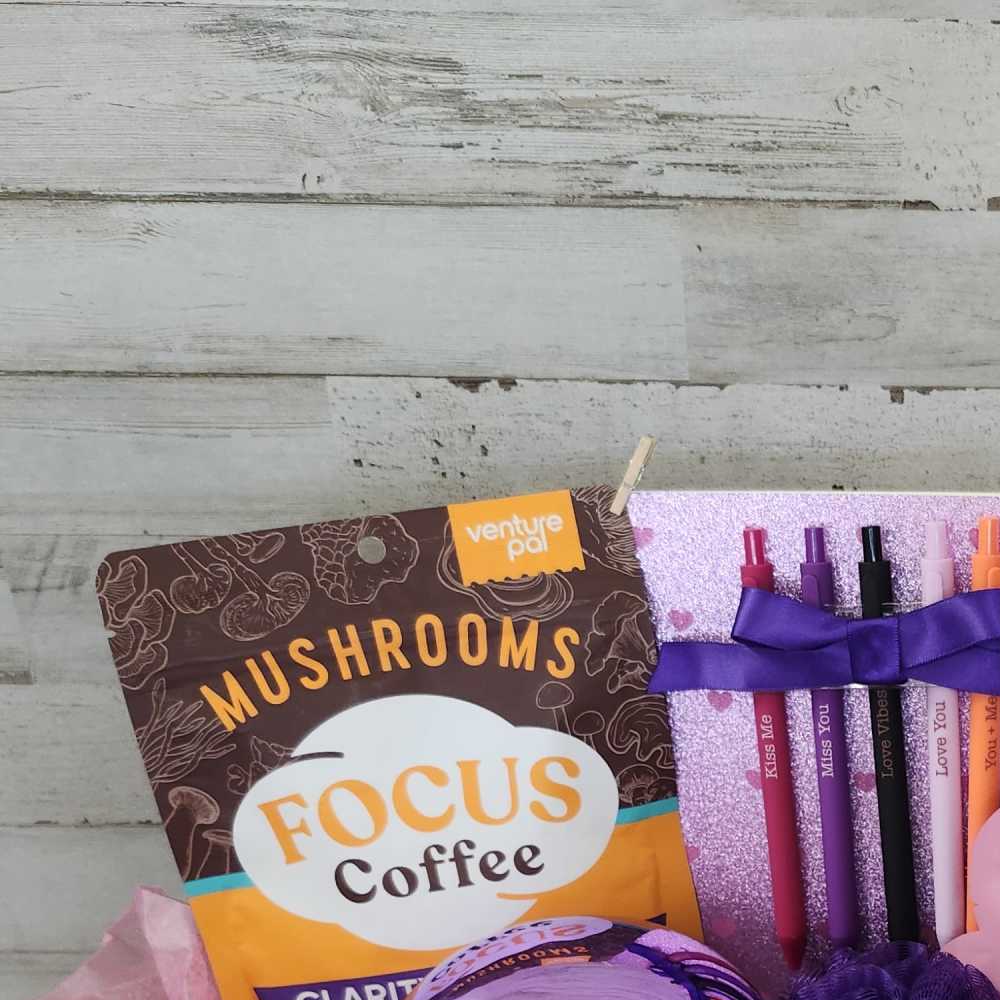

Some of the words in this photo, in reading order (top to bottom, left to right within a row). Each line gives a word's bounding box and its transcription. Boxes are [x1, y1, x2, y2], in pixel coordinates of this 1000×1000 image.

[465, 513, 563, 543] venture
[508, 518, 548, 561] pal
[199, 613, 580, 732] MUSHROOMS
[761, 714, 774, 741] Me
[818, 704, 830, 736] You
[876, 688, 891, 737] Vibes
[934, 701, 946, 735] You
[765, 743, 778, 779] Kiss
[820, 741, 834, 777] Miss
[881, 741, 894, 778] Love
[935, 737, 948, 776] Love
[985, 739, 997, 771] You
[258, 755, 582, 865] FOCUS
[334, 839, 546, 903] Coffee
